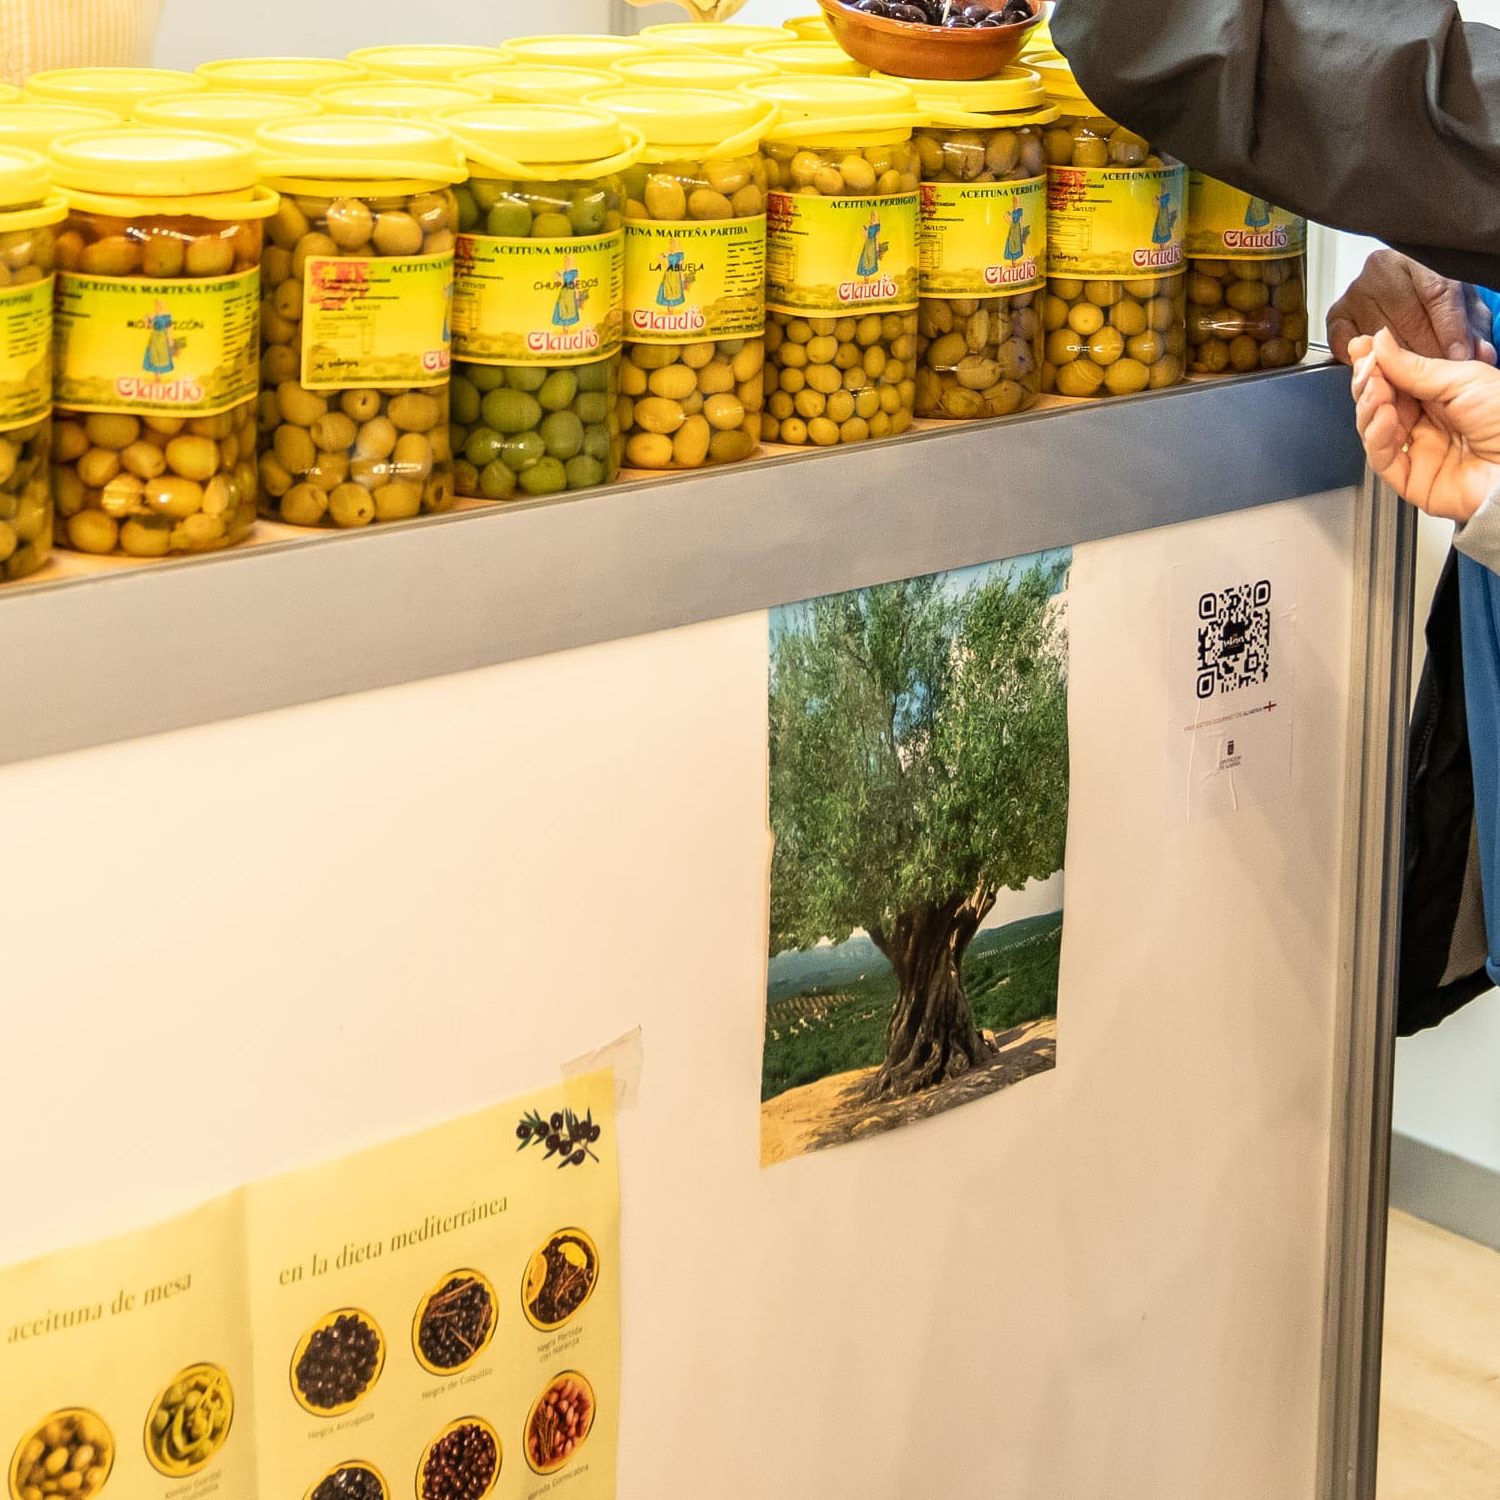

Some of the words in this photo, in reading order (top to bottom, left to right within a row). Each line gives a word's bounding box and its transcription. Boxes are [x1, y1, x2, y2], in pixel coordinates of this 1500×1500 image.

[1102, 172, 1150, 181] ACEITUNA
[960, 189, 1008, 199] ACEITUNA
[1010, 184, 1033, 196] VERDE
[830, 199, 877, 209] ACEITUNA
[625, 226, 652, 237] TUNA
[656, 227, 708, 238] MARTEÑA
[710, 226, 748, 237] PARTIDA
[1223, 229, 1287, 248] Claudio
[492, 245, 551, 255] ACEITUNA
[554, 243, 598, 255] MORONA
[648, 263, 662, 272] LA
[666, 263, 705, 272] ABUELA
[985, 263, 1037, 284] Claudio
[838, 277, 897, 301] Claudio
[632, 309, 705, 330] Claudio
[527, 328, 598, 351] Claudio
[116, 378, 203, 401] Claudio
[278, 1264, 304, 1286] en
[311, 1253, 328, 1277] la
[335, 1241, 383, 1270] dieta
[390, 1195, 509, 1252] mediterránea
[7, 1308, 103, 1345] aceituna
[111, 1288, 136, 1315] de
[143, 1272, 193, 1306] mesa
